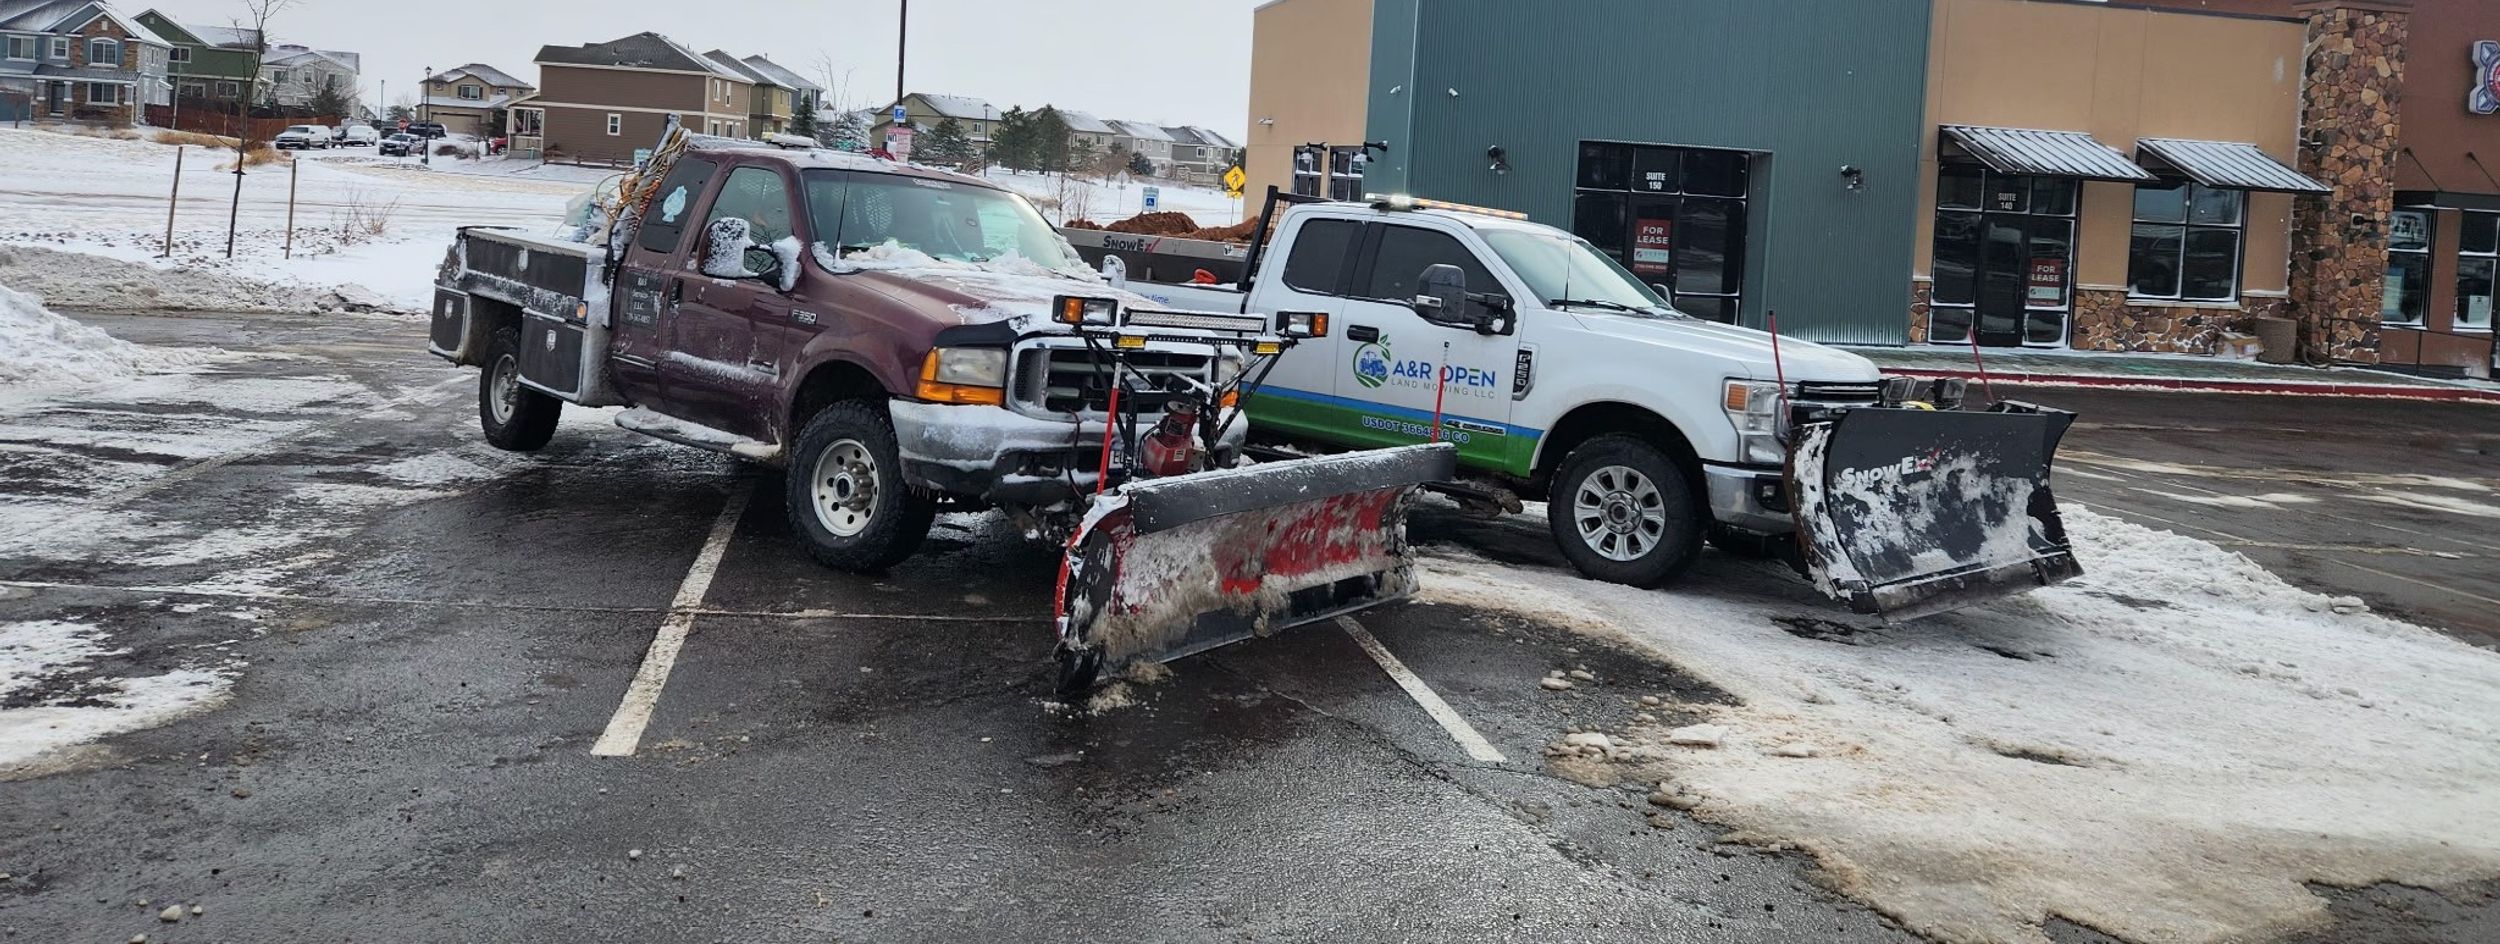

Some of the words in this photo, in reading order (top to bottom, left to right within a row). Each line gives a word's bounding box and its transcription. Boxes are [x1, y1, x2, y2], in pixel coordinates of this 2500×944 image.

[1645, 171, 1666, 181] SUITE
[1648, 181, 1662, 190] 150
[1998, 192, 2017, 202] SUITE
[2000, 202, 2013, 210] 140
[1642, 226, 1664, 235] FOR
[1636, 235, 1669, 244] LEASE
[2036, 264, 2056, 273] FOR
[2031, 273, 2060, 282] LEASE
[1392, 360, 1432, 380] A&R
[1439, 365, 1496, 388] OPEN
[1391, 379, 1418, 389] LAND
[1474, 389, 1495, 400] LLC
[1361, 414, 1400, 432] USDOT
[1451, 430, 1470, 443] CO
